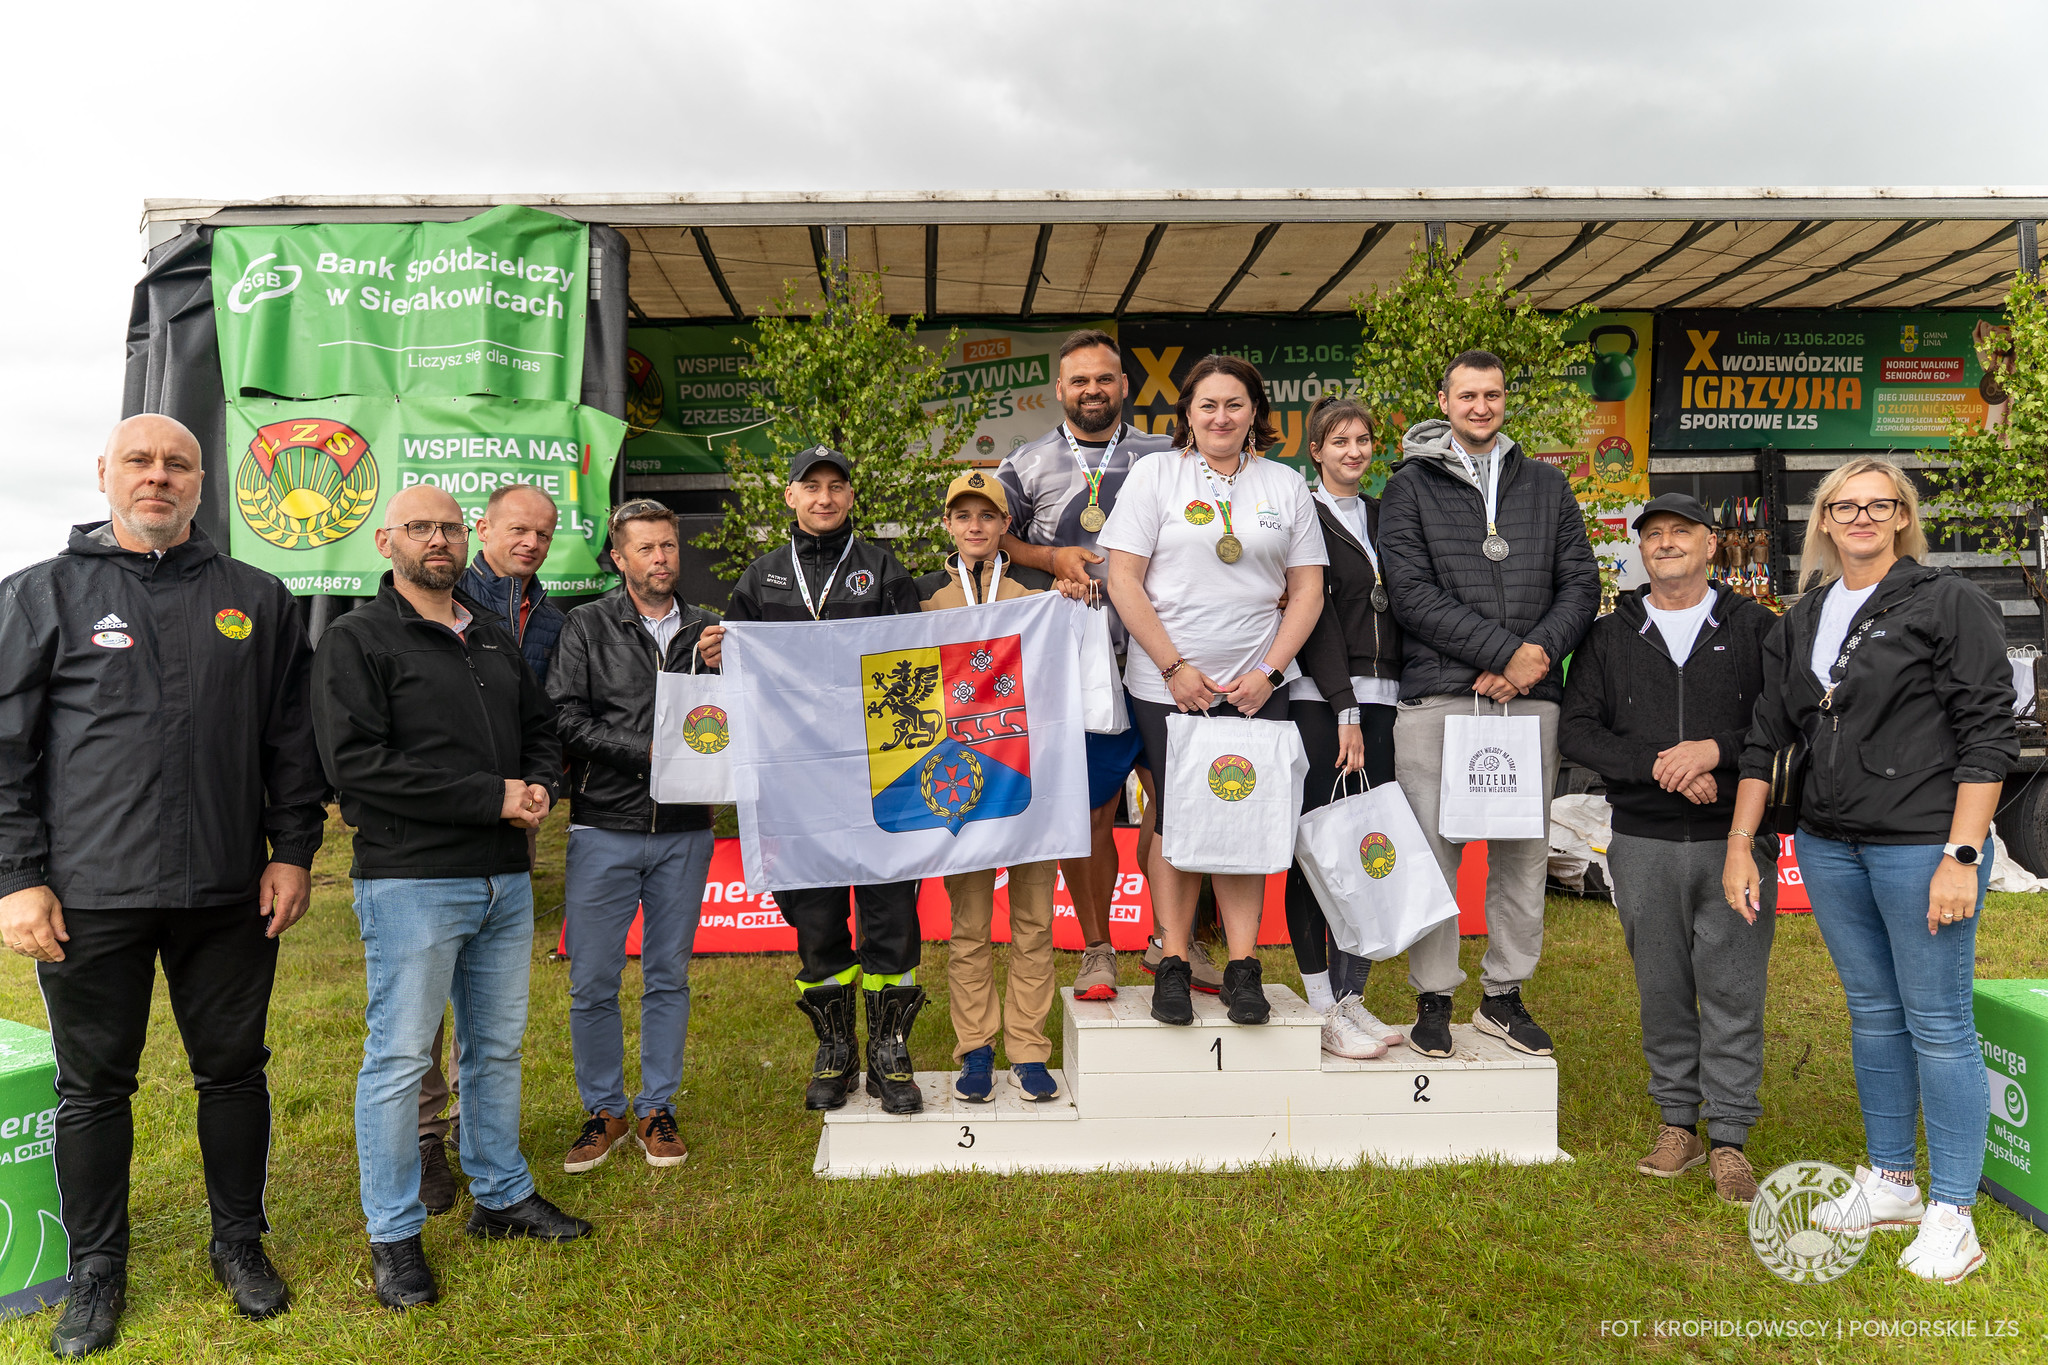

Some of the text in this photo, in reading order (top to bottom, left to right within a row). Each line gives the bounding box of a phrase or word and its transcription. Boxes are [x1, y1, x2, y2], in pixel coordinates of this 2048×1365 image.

[316, 246, 575, 292] Bank spółdzielczy
[243, 271, 282, 293] SGB
[326, 281, 564, 319] w Sierakowicach
[1737, 331, 1771, 345] Linia
[1783, 333, 1865, 346] 13.06.2026
[1922, 332, 1948, 340] GMINA
[1922, 339, 1942, 347] LINIA
[968, 341, 1006, 359] 2026
[1684, 330, 1720, 371] X
[408, 348, 541, 373] Liczysz się dla nas
[1722, 351, 1864, 373] WOJEWÓDZKIE
[1886, 360, 1960, 370] NORDIC WALKING
[935, 360, 1045, 396] KTYWNA
[1131, 346, 1184, 407] X
[1885, 370, 1951, 380] SENIORÓW 60+
[680, 382, 783, 400] POMORSKI
[1681, 375, 1862, 410] IGRZYSKA
[1878, 393, 1897, 402] BIEG
[953, 389, 1014, 426] WEŚ
[1877, 404, 1886, 414] O
[1887, 404, 1920, 416] ZŁOTĄ
[1921, 402, 1940, 414] NIĆ
[1679, 413, 1819, 430] SPORTOWE LZS
[257, 423, 356, 462] LZS
[403, 437, 579, 463] WSPIERA NAS
[1600, 439, 1628, 452] LZS
[1259, 520, 1283, 532] PUCK
[219, 609, 244, 618] LZS
[93, 622, 129, 631] adidas
[690, 707, 724, 722] LZS
[1215, 757, 1249, 770] LZS
[1468, 774, 1517, 786] MUZEUM
[1361, 835, 1384, 852] LZS
[741, 913, 785, 927] ORLE
[1210, 1037, 1223, 1071] 1
[1413, 1074, 1431, 1103] 2
[957, 1125, 975, 1148] 3
[1994, 1122, 2031, 1153] włącza
[1985, 1137, 2031, 1175] rzyszłość
